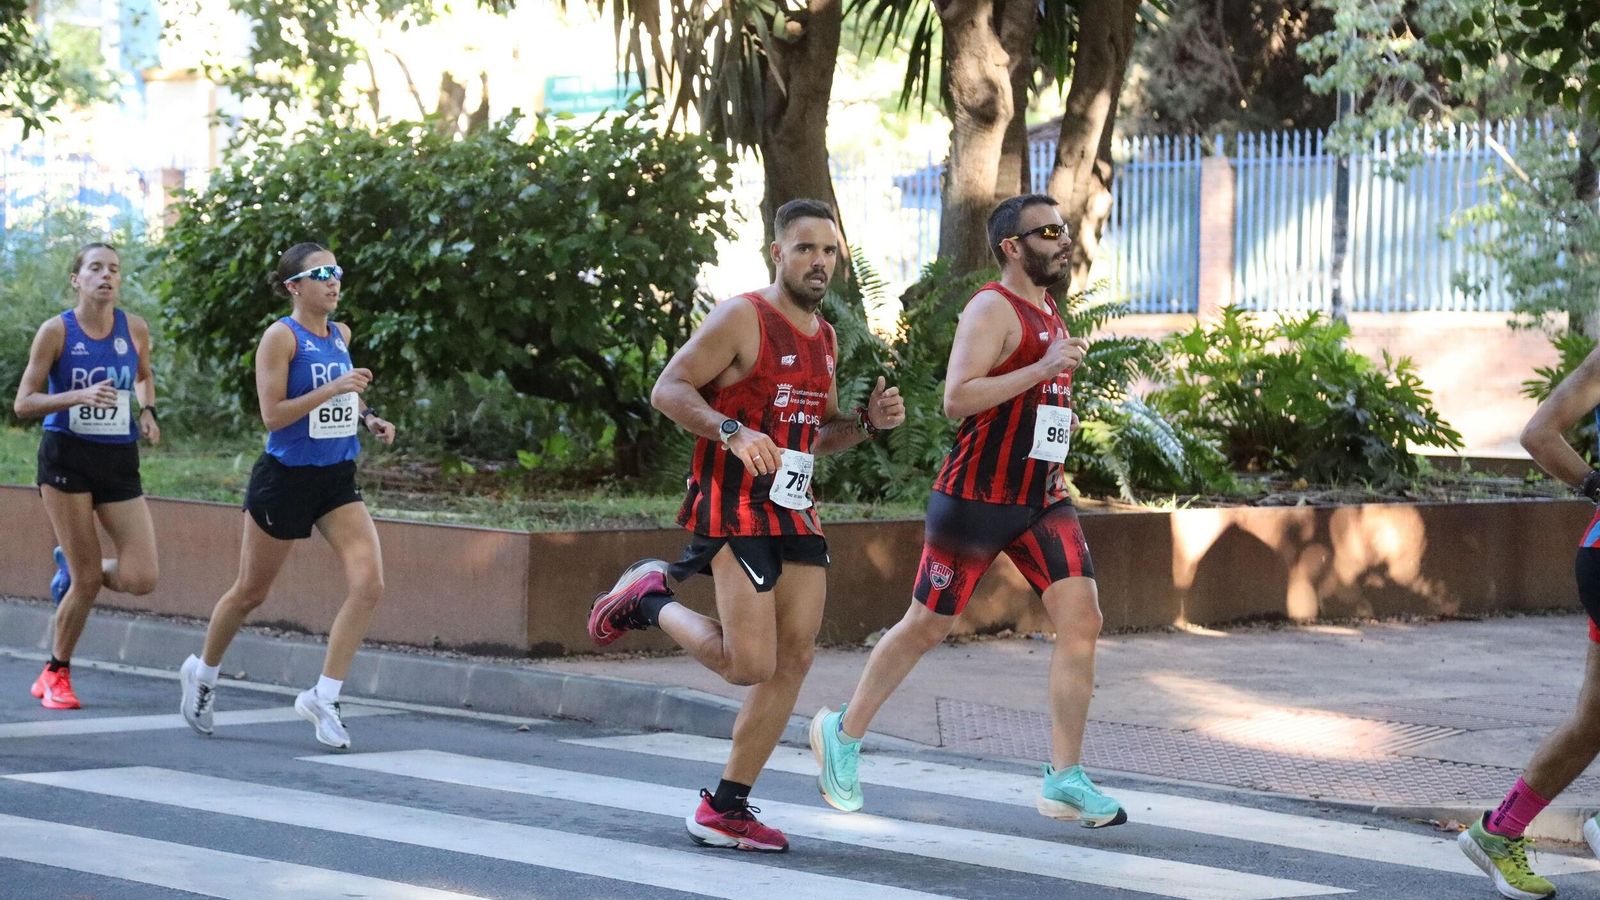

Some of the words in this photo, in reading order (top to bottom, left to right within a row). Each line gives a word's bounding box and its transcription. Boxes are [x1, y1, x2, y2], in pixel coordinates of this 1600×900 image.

[79, 406, 118, 420] 807
[319, 407, 353, 423] 602
[1047, 427, 1069, 444] 986
